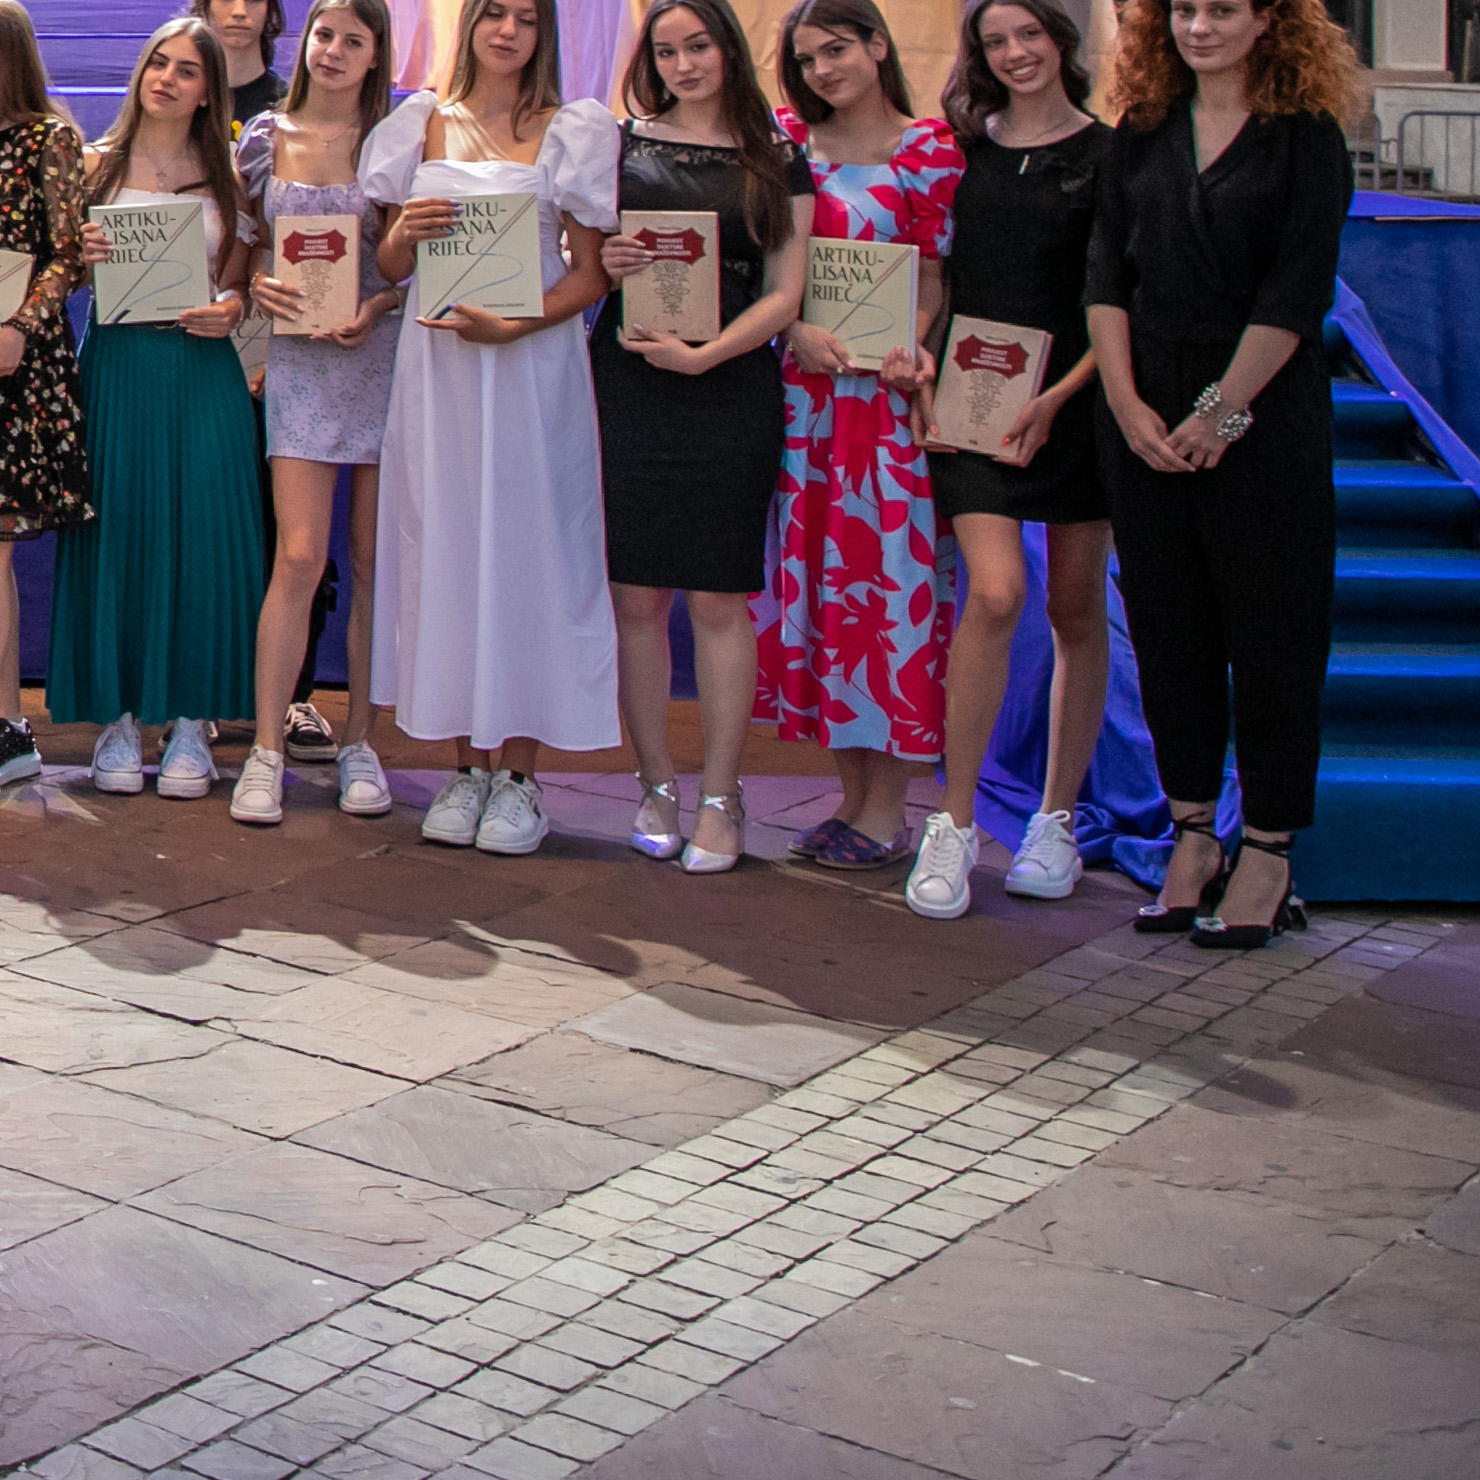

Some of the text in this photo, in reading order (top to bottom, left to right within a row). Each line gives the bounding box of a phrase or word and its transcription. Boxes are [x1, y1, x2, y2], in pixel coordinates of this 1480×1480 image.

[101, 211, 176, 229] ARTIKU-
[428, 236, 476, 256] RIJEČ
[812, 247, 884, 266] ARTIKU-
[813, 264, 873, 284] LISANA
[812, 283, 856, 303] RIJEČ
